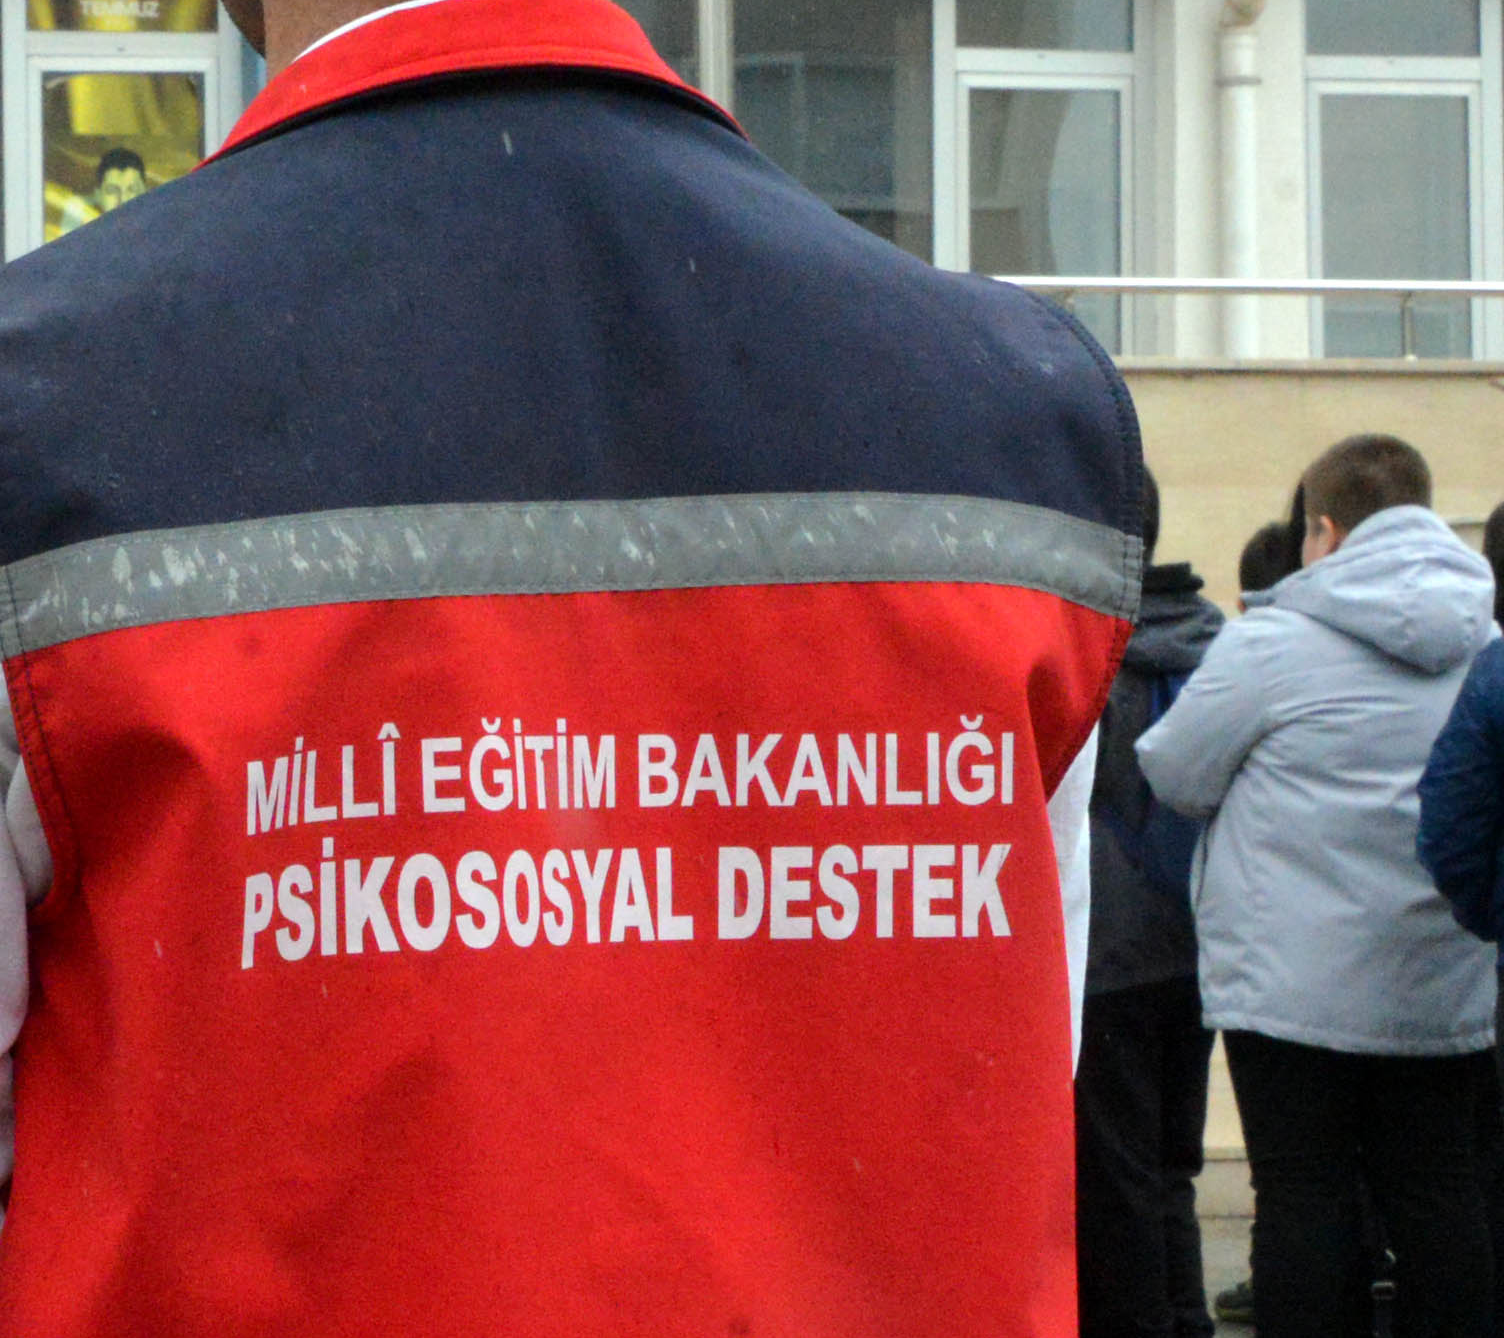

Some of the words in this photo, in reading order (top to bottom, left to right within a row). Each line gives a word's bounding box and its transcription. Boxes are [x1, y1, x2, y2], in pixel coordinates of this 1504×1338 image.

[246, 722, 402, 836] MİLLÎ
[421, 717, 617, 814] EĞİTİM
[638, 713, 1015, 809] BAKANLIĞI
[240, 836, 694, 970] PSİKOSOSYAL
[718, 842, 1014, 940] DESTEK
